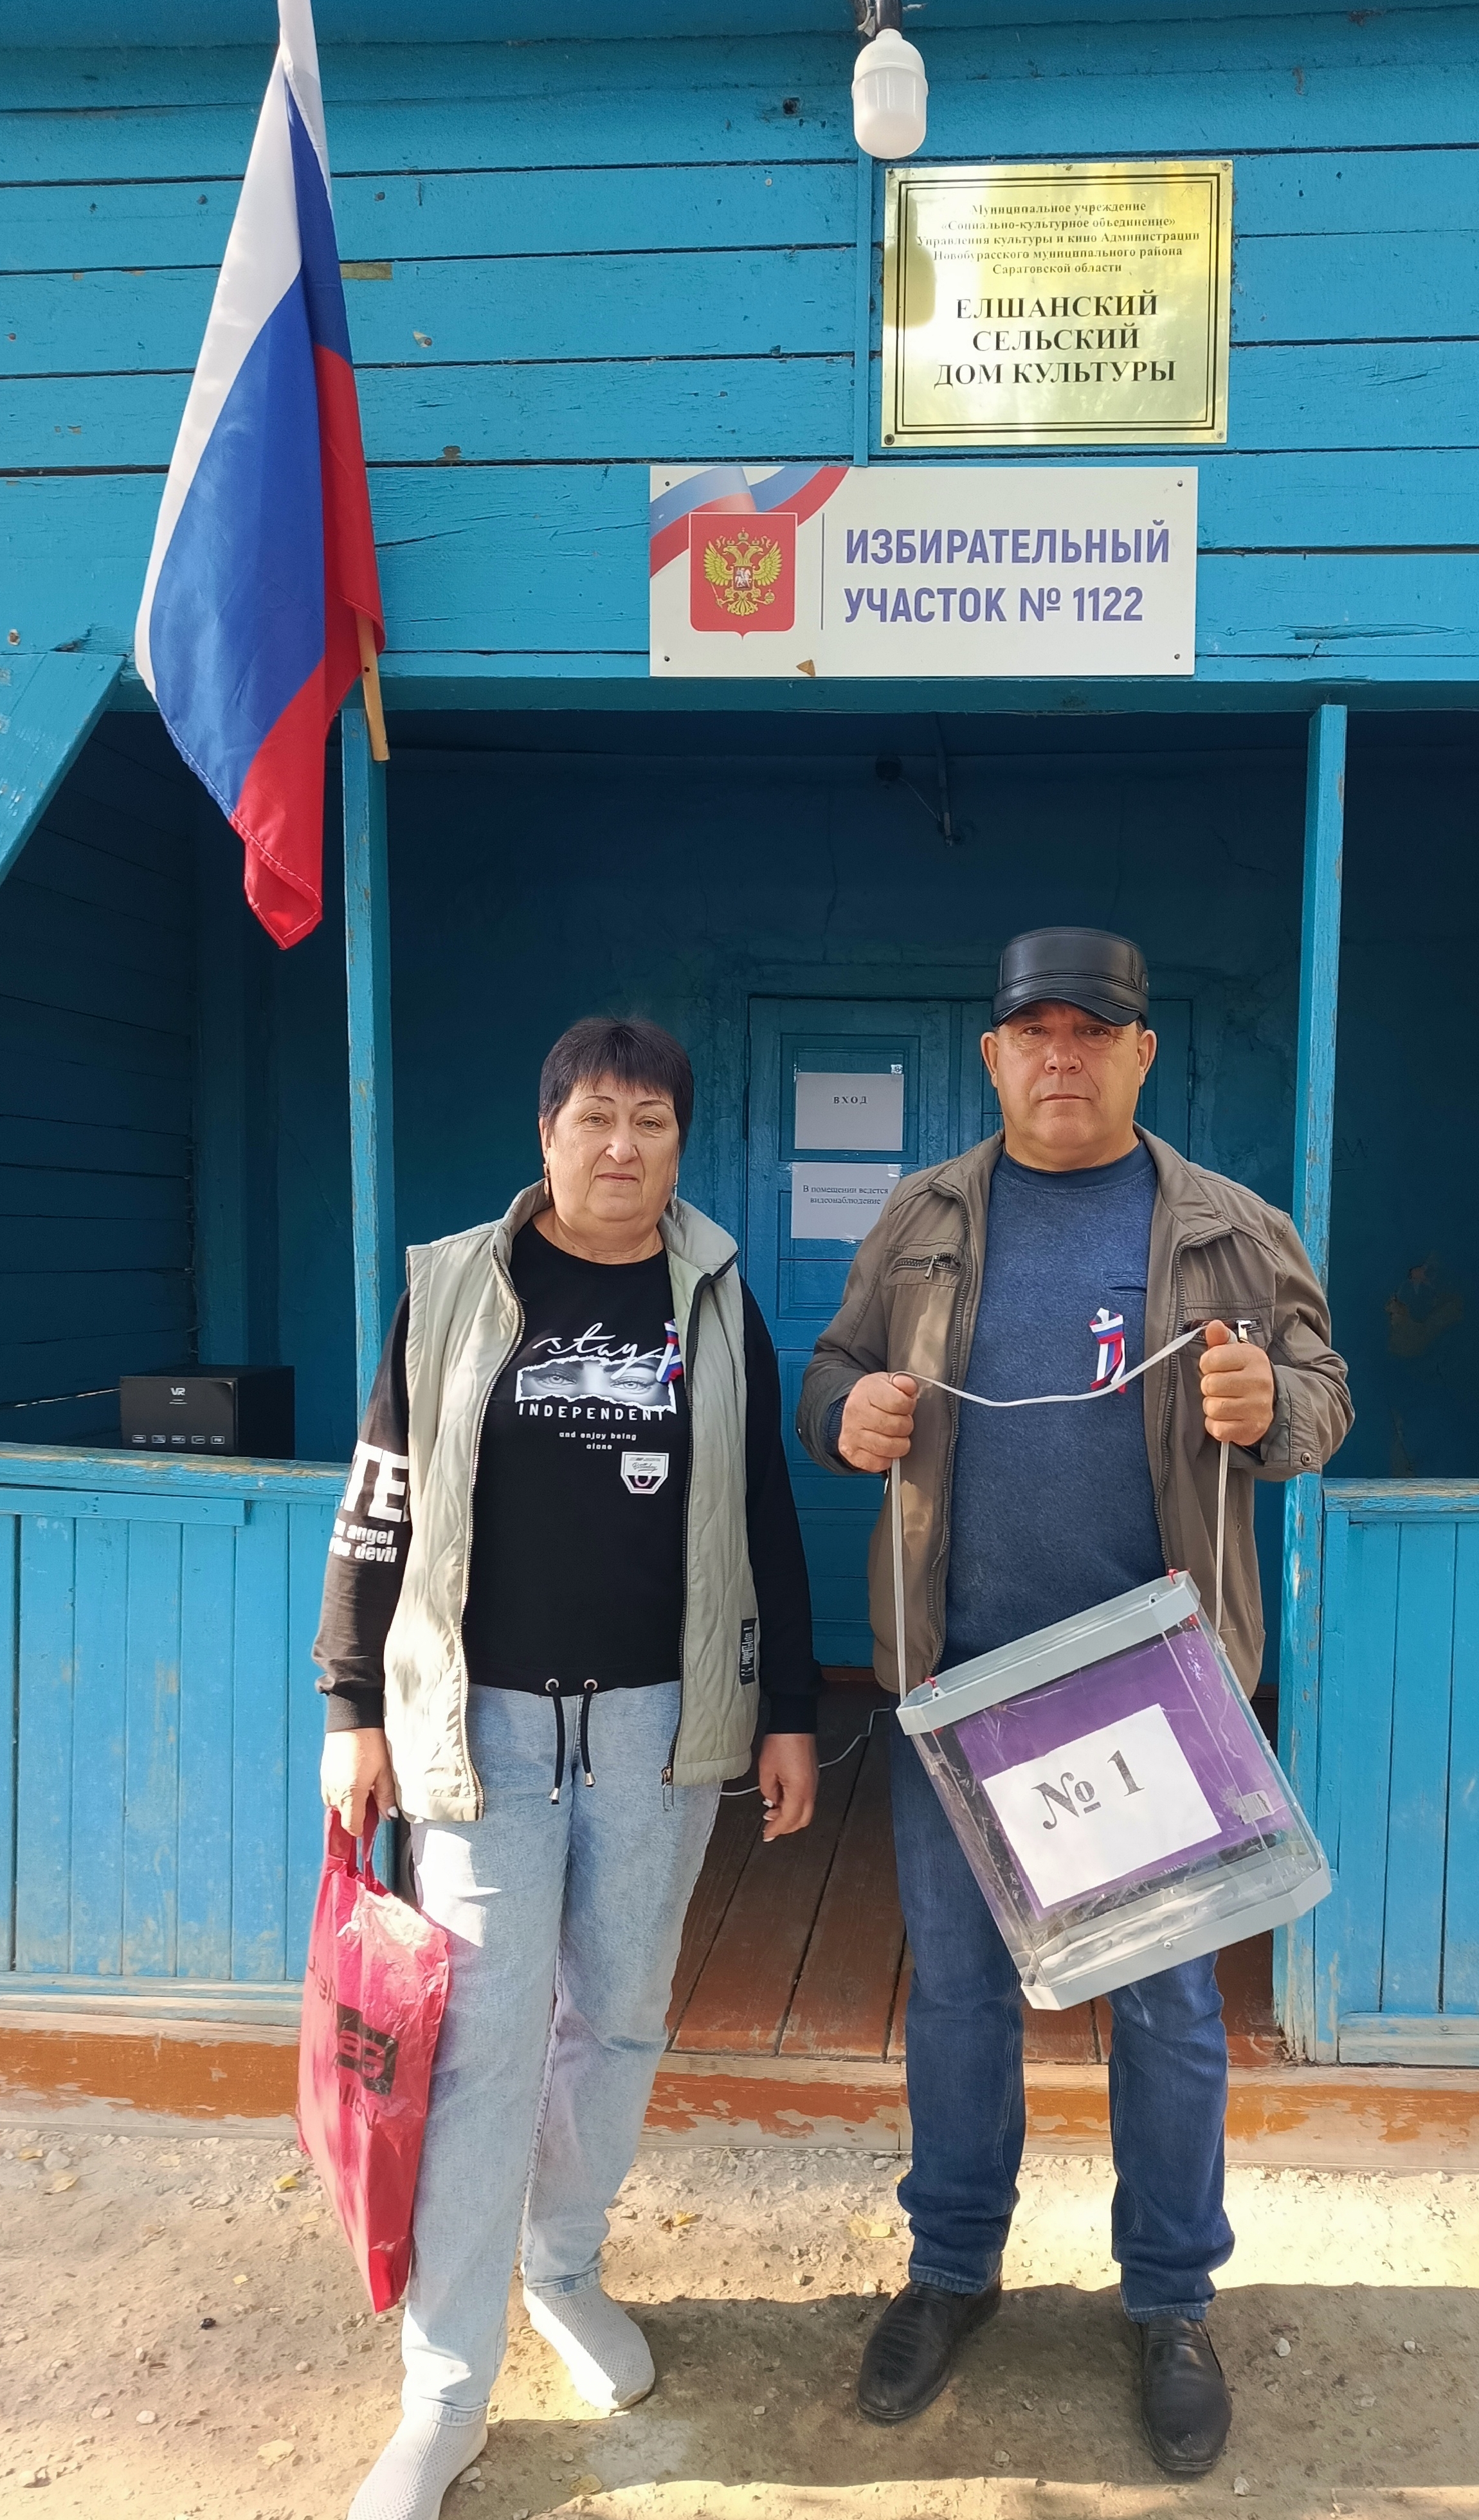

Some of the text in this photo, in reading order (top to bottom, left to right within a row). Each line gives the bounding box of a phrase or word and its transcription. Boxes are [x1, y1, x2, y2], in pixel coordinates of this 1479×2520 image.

[970, 203, 1147, 217] Муниципальное учреждение
[916, 232, 1200, 248] Управления культуры и кино Администрации
[934, 246, 1183, 262] Новобурасского муниципального района
[993, 262, 1122, 276] Саратовской области
[956, 289, 1159, 319] ЕЛШАНСКИЙ
[973, 322, 1141, 351] СЕЛЬСКИЙ
[934, 360, 1177, 389] ДОМ КУЛЬТУРЫ
[846, 520, 1169, 564] ИЗБИРАТЕЛЬНЫЙ
[844, 586, 1143, 623] УЧАСТОК № 1122
[833, 1096, 868, 1105] ВХОД
[532, 1322, 664, 1380] stay
[170, 1388, 186, 1396] VR
[518, 1402, 665, 1421] INDEPENDENT
[610, 1433, 637, 1441] being
[347, 1525, 394, 1546] angel
[354, 1543, 397, 1563] devil
[1030, 1749, 1145, 1830] № 1
